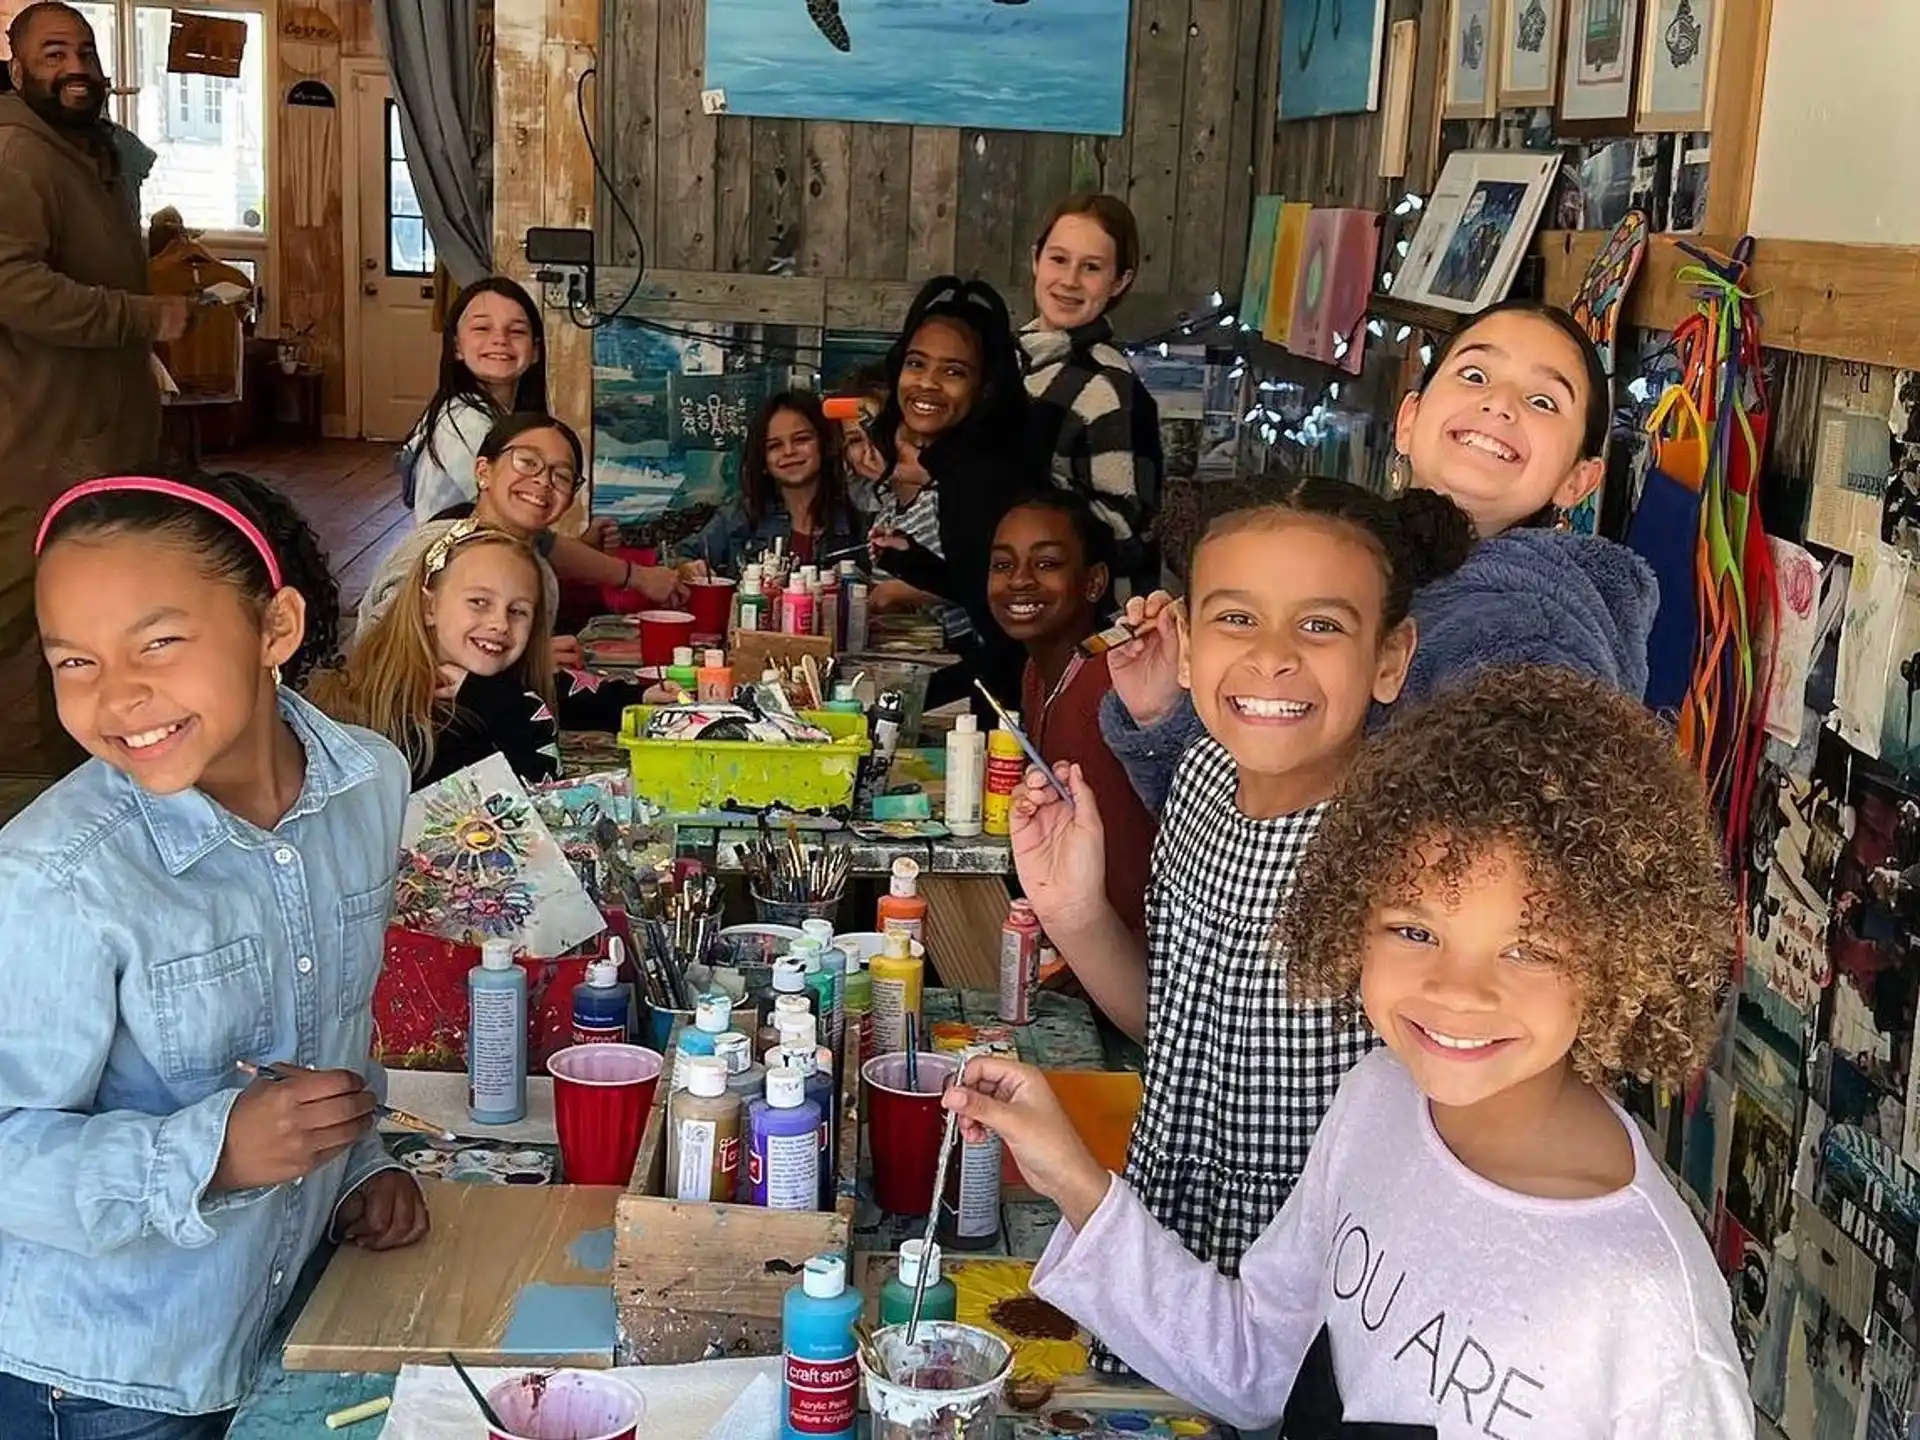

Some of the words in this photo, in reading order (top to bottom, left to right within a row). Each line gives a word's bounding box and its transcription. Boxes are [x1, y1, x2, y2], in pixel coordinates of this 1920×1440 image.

[1864, 1173, 1883, 1213] TO
[1841, 1197, 1896, 1270] WATER
[789, 1365, 819, 1383] craft
[1394, 1310, 1545, 1440] ARE
